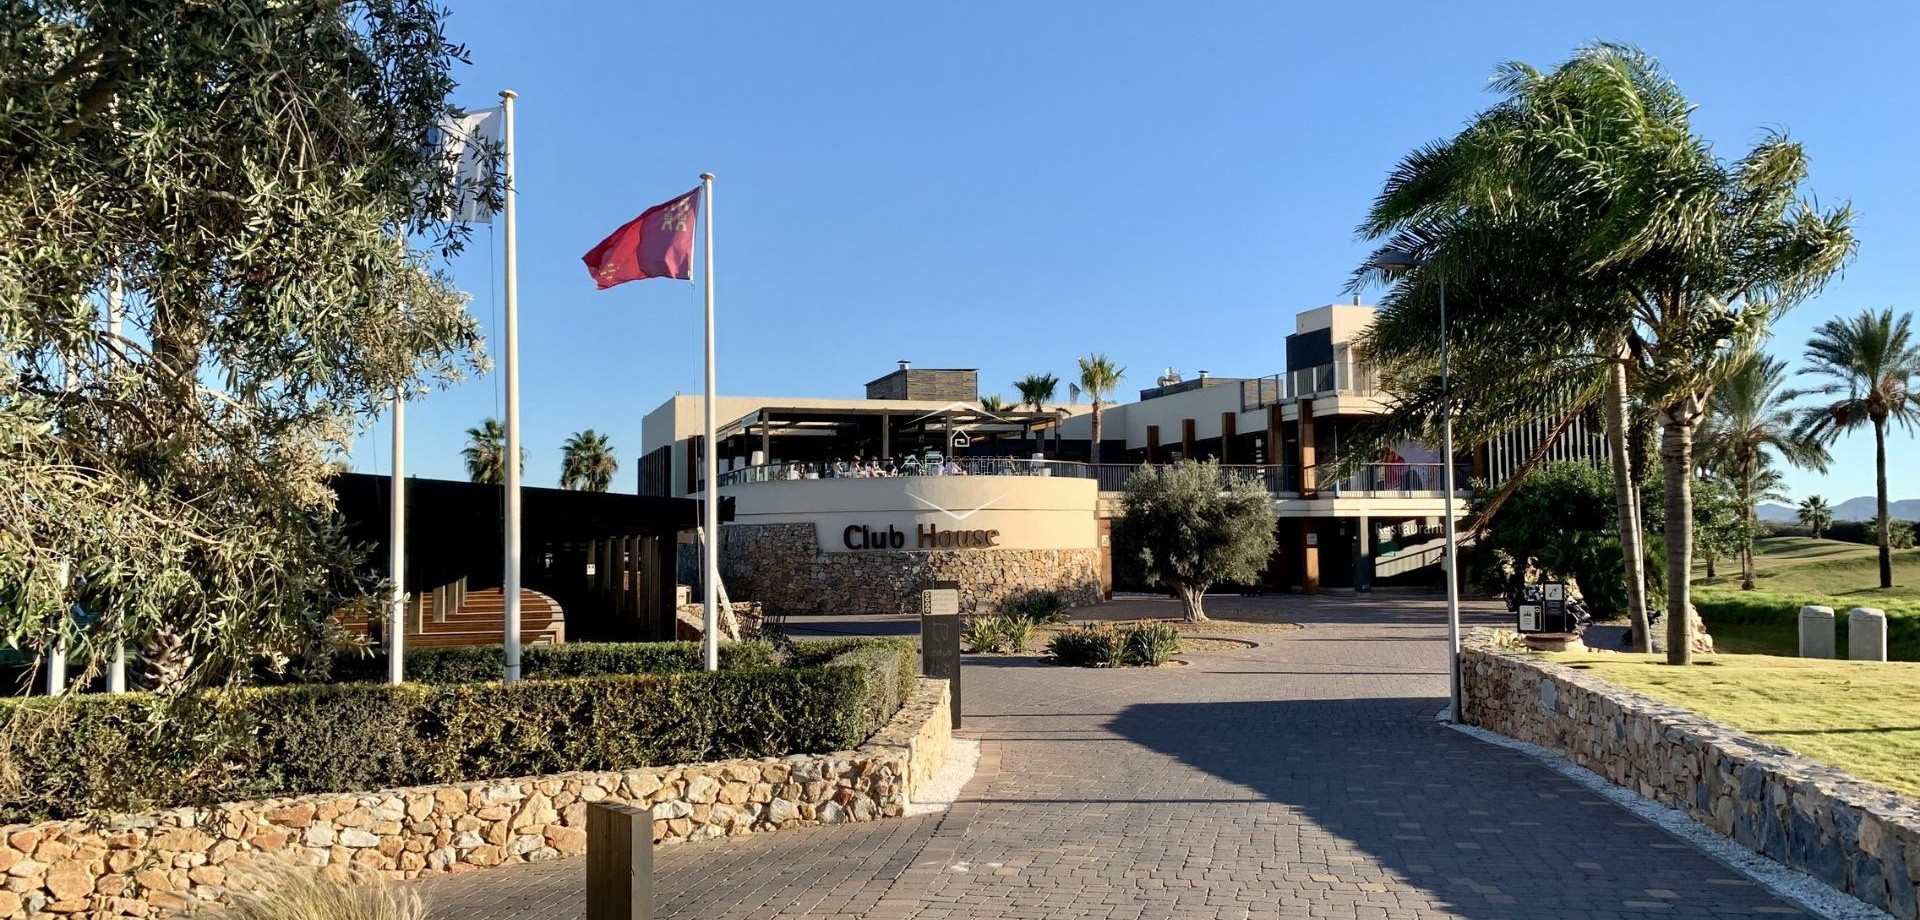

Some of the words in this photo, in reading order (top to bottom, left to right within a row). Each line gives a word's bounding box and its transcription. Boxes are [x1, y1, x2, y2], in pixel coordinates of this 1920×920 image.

[843, 524, 905, 550] Club
[917, 523, 1000, 549] House
[1375, 521, 1445, 535] Restaurant
